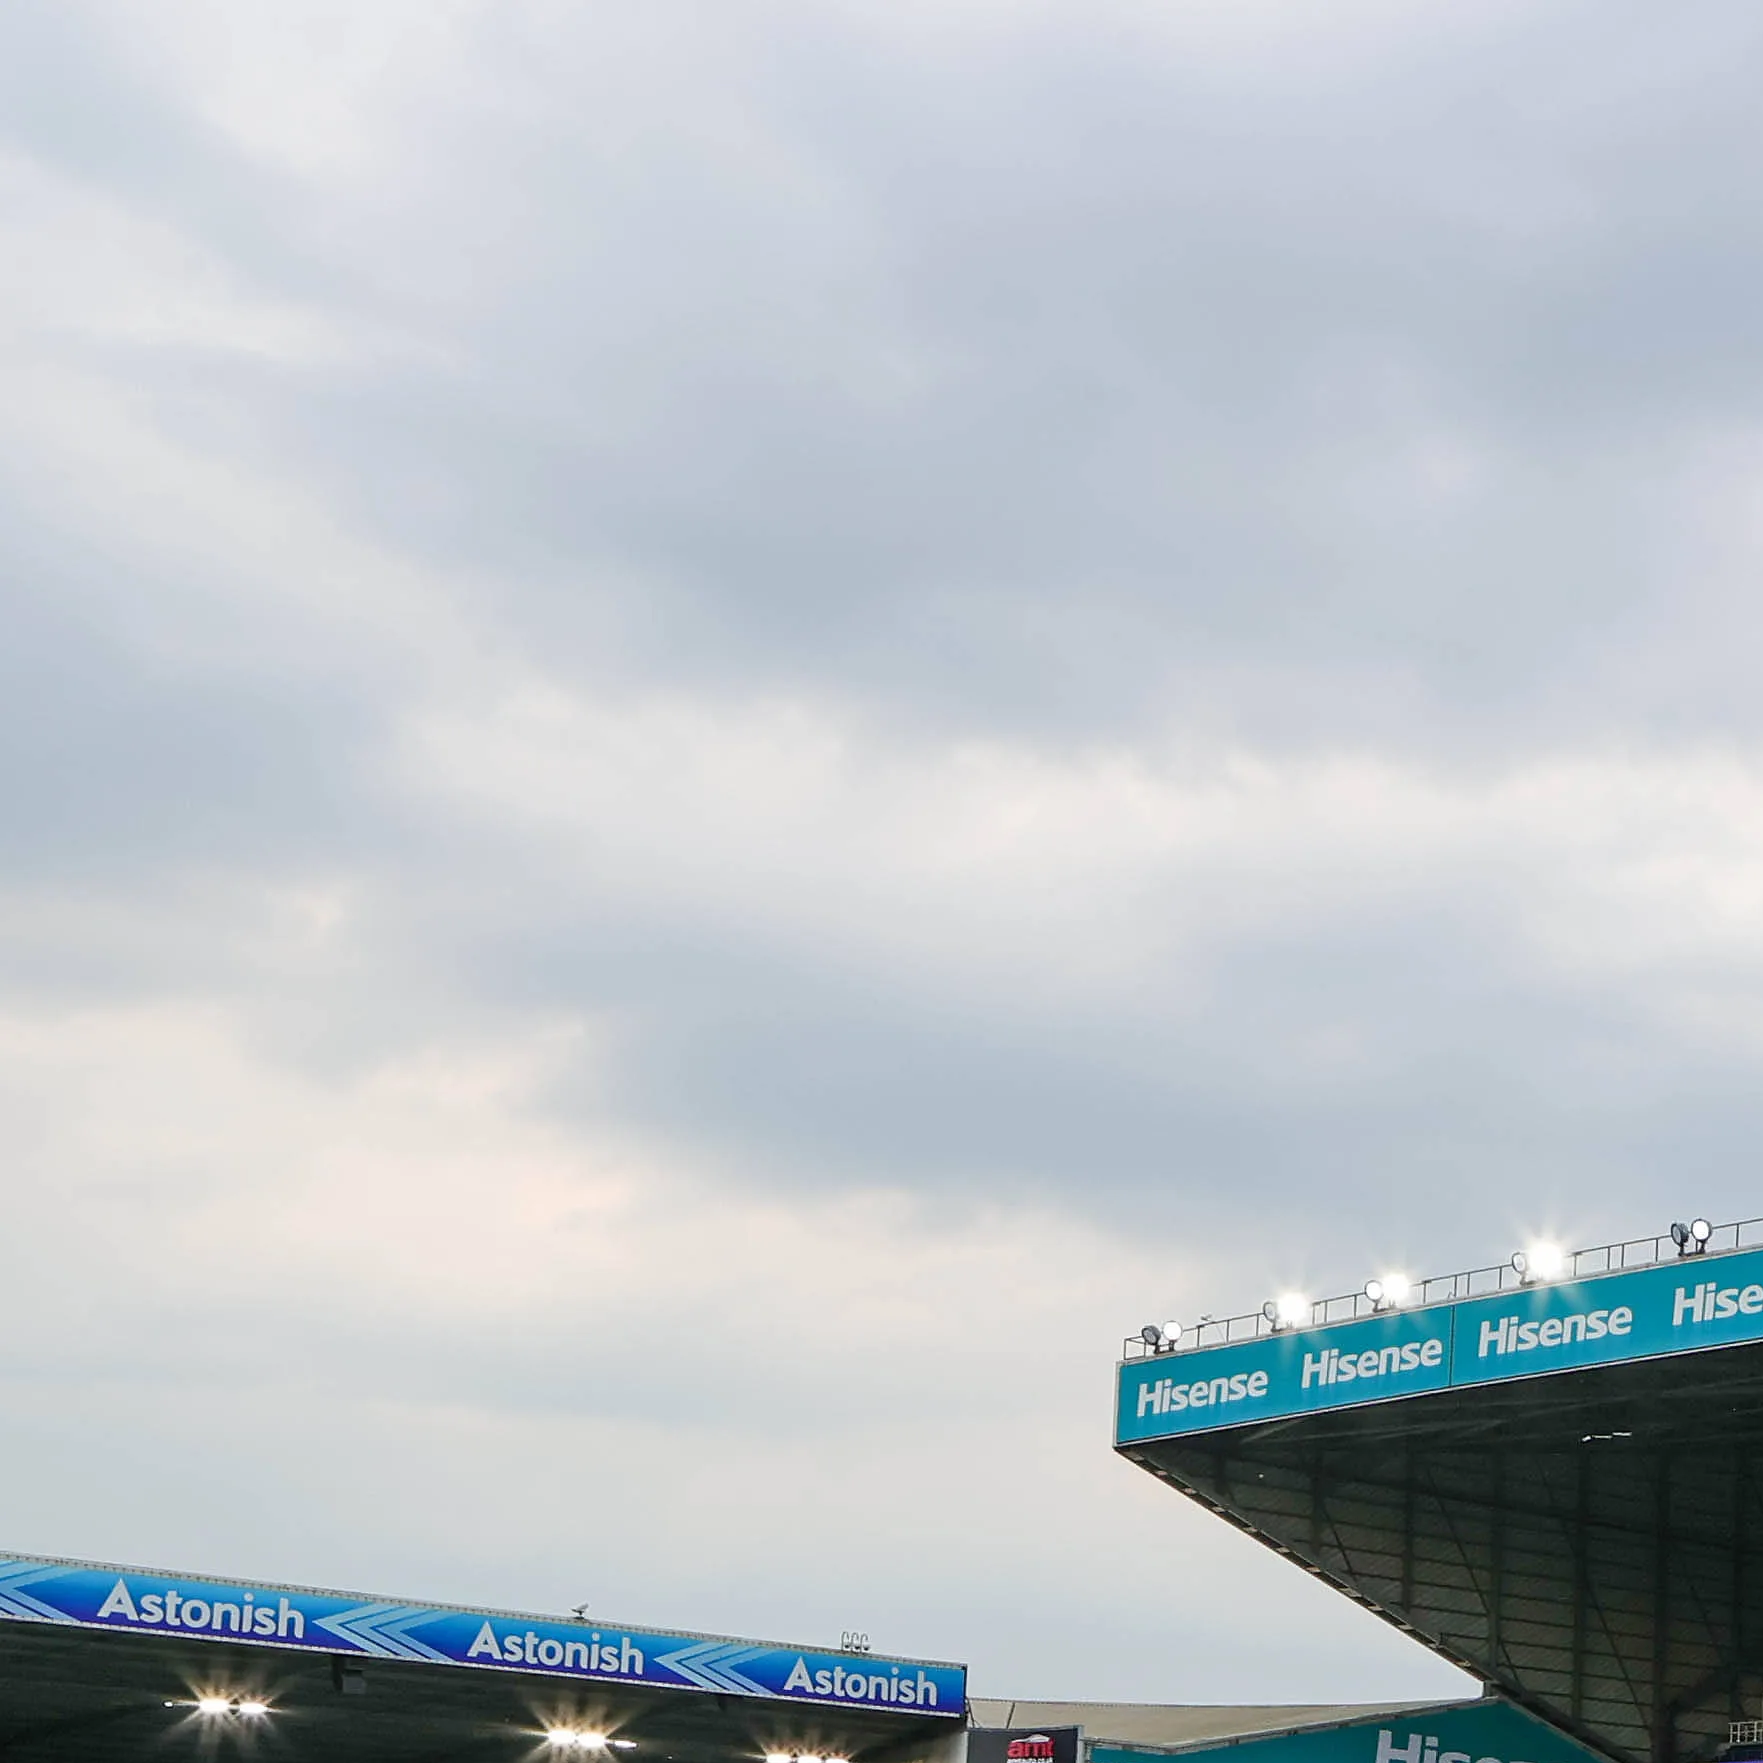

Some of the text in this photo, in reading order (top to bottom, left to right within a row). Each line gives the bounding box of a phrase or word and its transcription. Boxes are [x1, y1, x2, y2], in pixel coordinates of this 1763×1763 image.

[1479, 1300, 1633, 1358] Hisense
[1301, 1334, 1442, 1390] Hisense
[1137, 1367, 1268, 1418] Hisense
[98, 1577, 305, 1640] Astonish
[467, 1620, 643, 1675] Astonish
[784, 1655, 937, 1707] Astonish
